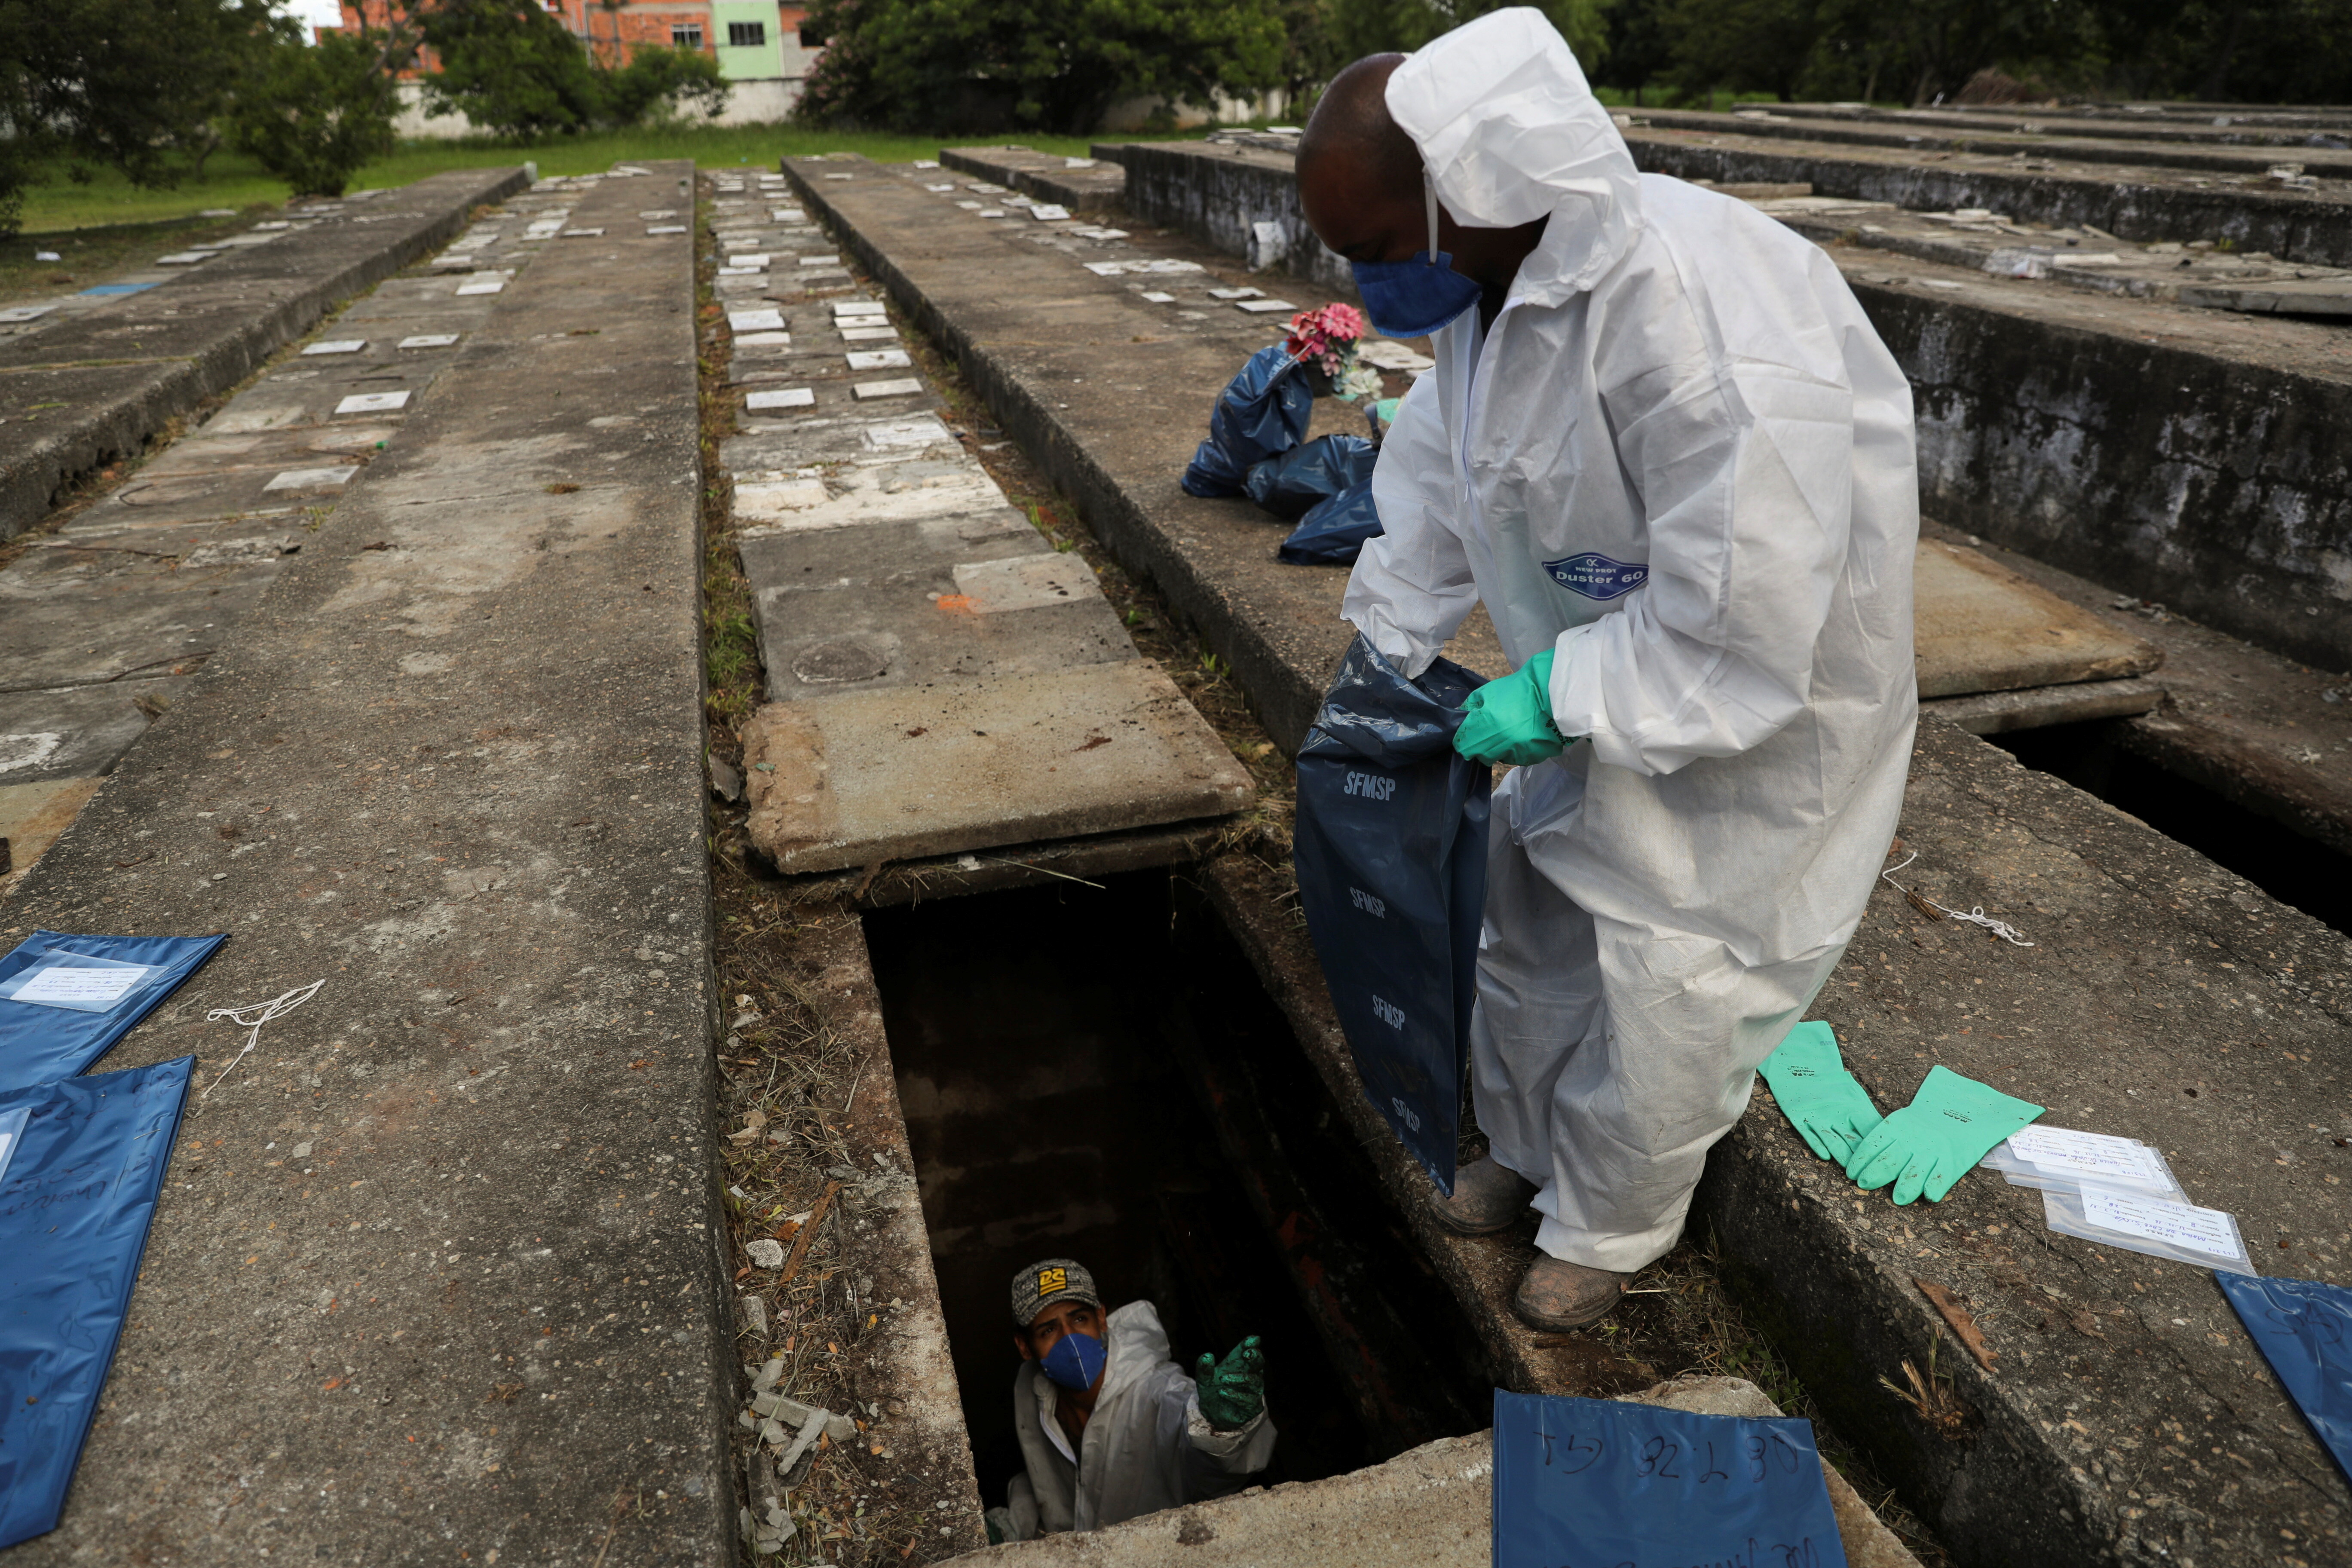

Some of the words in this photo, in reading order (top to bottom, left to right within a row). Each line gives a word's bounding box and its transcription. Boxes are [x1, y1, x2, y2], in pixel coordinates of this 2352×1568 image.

[1556, 571, 1613, 584] Duster
[1621, 570, 1644, 583] 60
[1344, 771, 1396, 801] SFMSP
[1349, 886, 1386, 919] SFMSP
[1372, 994, 1406, 1031] SFMSP
[1391, 1096, 1421, 1135] SFMSP
